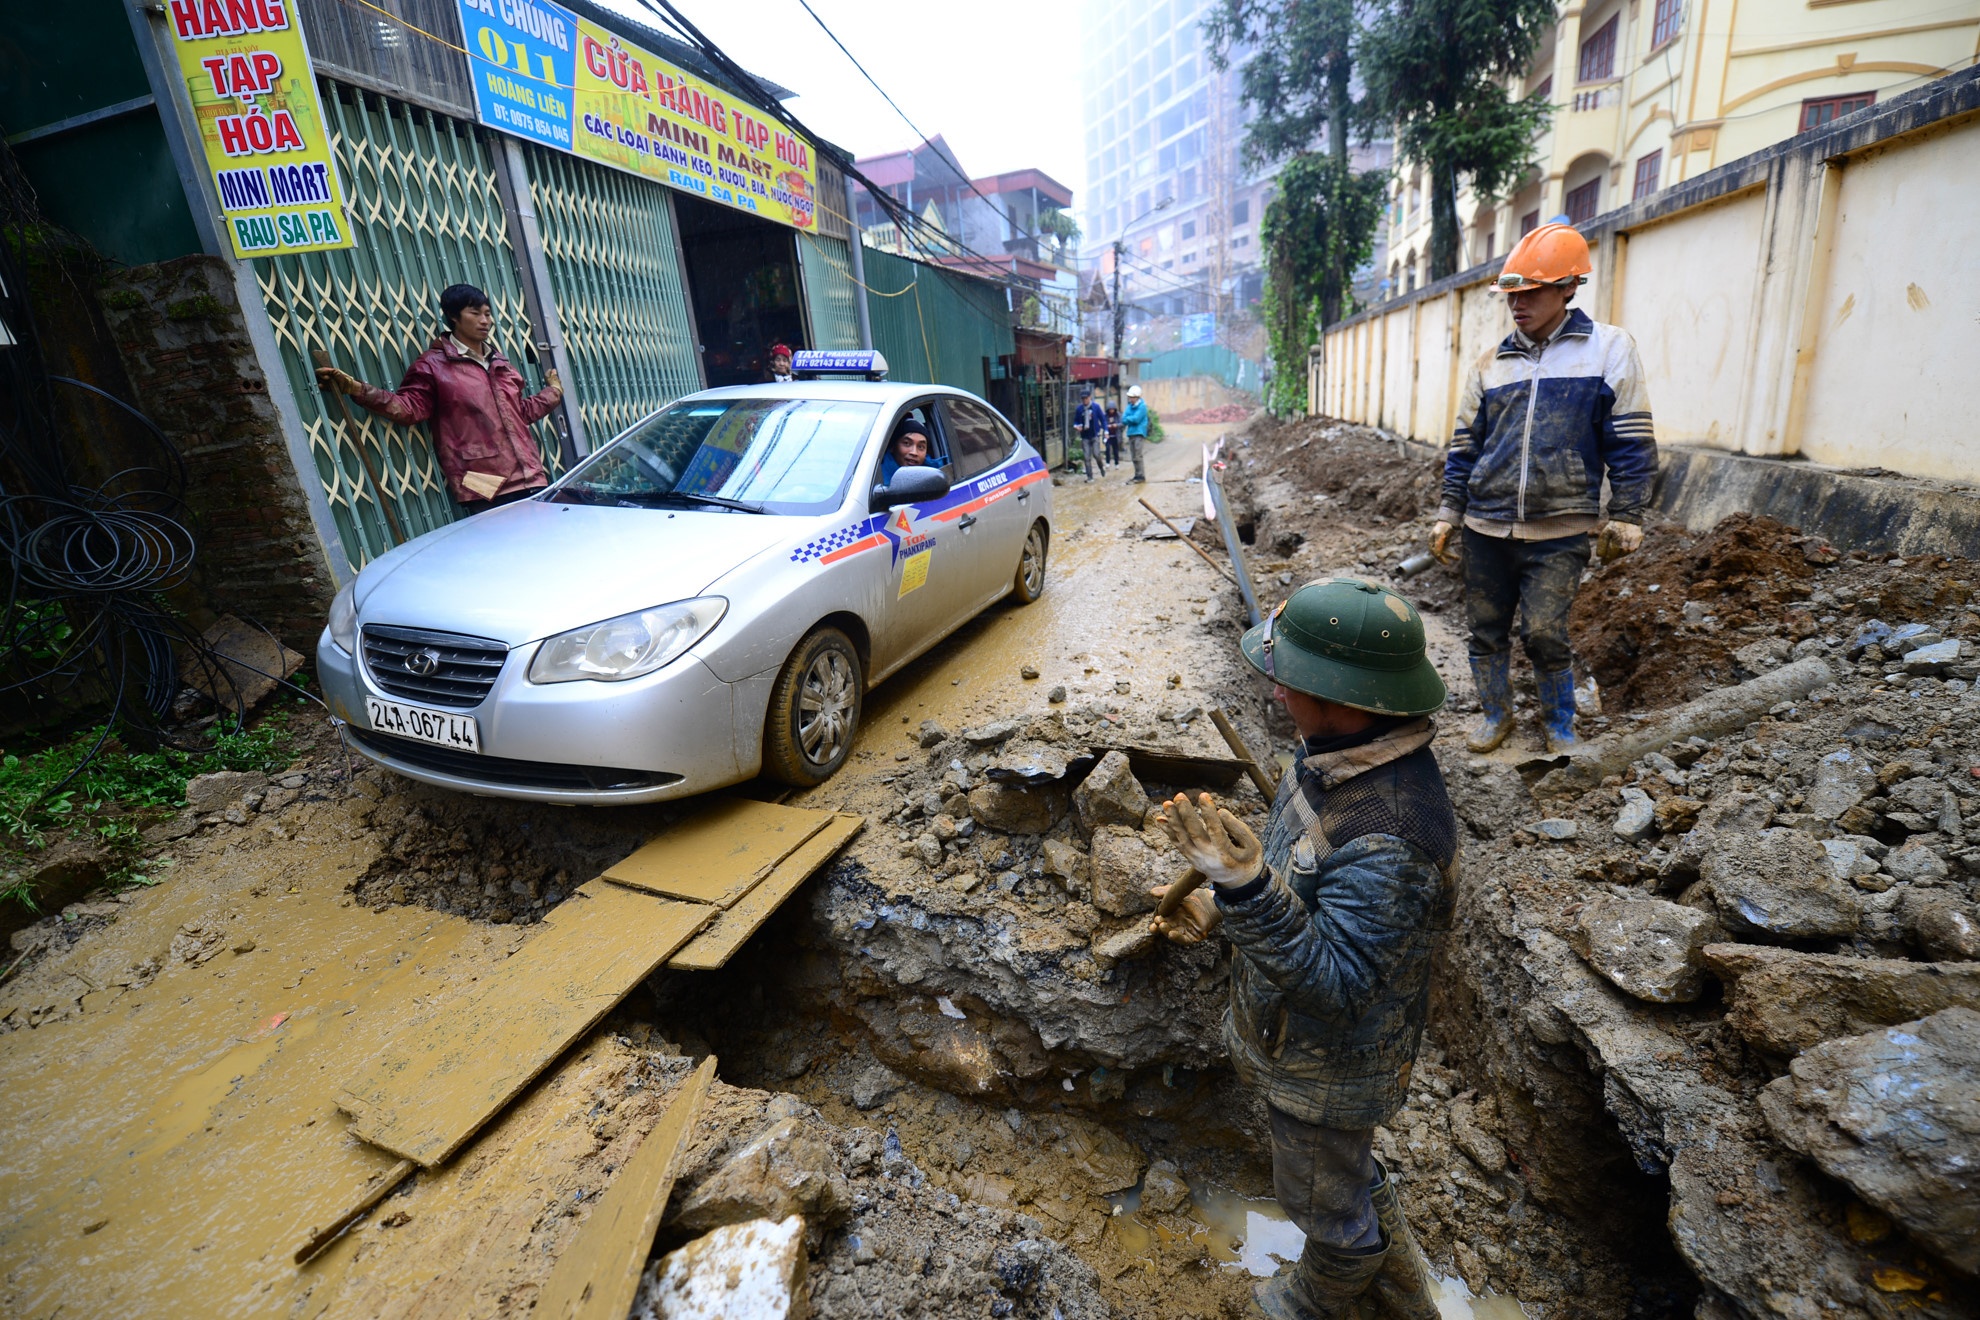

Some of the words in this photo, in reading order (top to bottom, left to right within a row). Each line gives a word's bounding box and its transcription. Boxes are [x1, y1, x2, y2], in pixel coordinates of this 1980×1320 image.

[203, 54, 279, 100] TẠP
[477, 26, 563, 90] 011
[486, 72, 537, 109] HOÀNG
[218, 107, 302, 153] HÓA
[510, 109, 534, 131] 0975
[534, 117, 552, 138] 854
[656, 71, 727, 135] HÀNG
[731, 109, 769, 153] TẠP
[774, 130, 809, 172] HÓA
[648, 112, 709, 155] MINI
[717, 142, 772, 180] MART
[218, 169, 270, 208] MINI
[269, 164, 330, 204] MART
[669, 169, 706, 193] RAU
[711, 185, 733, 203] SA
[737, 194, 757, 210] PA
[234, 217, 276, 248] RAU
[278, 214, 308, 244] SA
[307, 211, 339, 242] PA
[797, 350, 825, 358] TAXI
[846, 359, 857, 367] 62
[858, 359, 869, 367] 62
